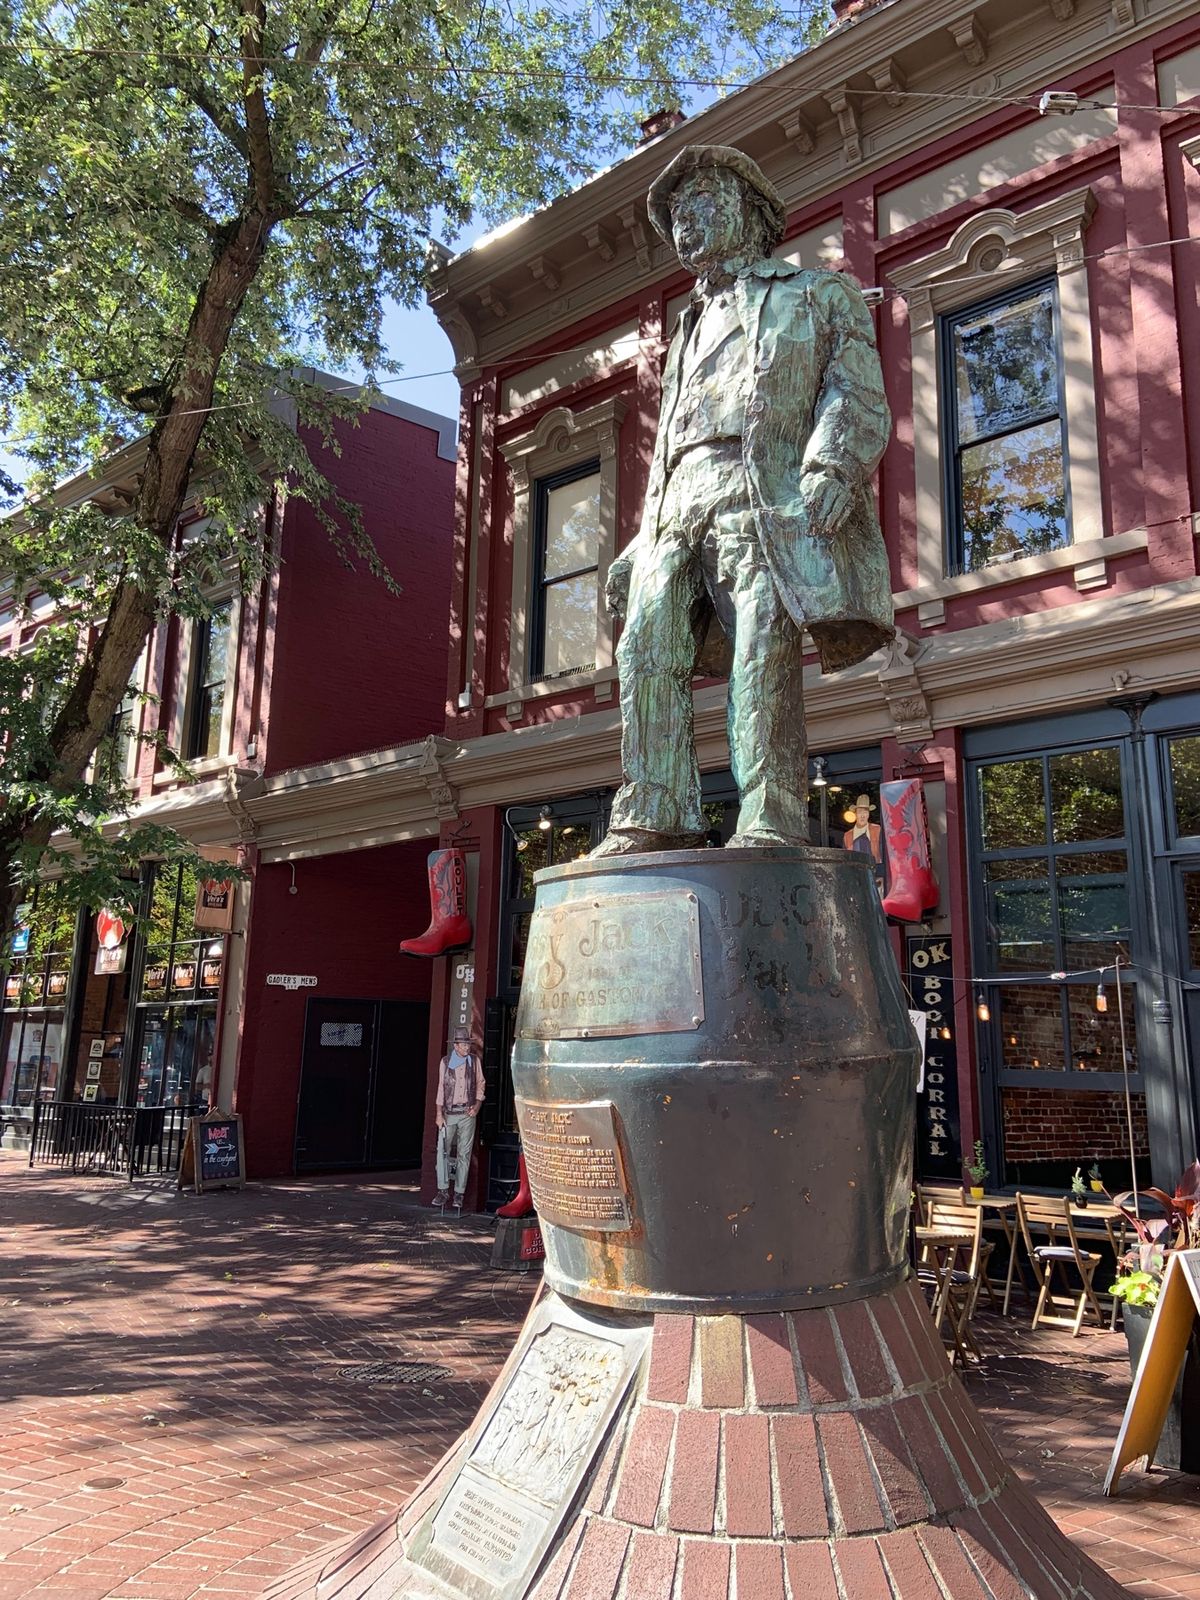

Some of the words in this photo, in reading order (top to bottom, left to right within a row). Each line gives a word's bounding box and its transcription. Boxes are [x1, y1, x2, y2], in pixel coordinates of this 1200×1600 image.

[454, 855, 463, 915] BOULET
[207, 895, 224, 903] Vera's
[912, 942, 951, 969] OK
[268, 975, 297, 984] GAOLER'S
[301, 977, 316, 985] MEWS
[456, 964, 475, 983] OK
[459, 988, 468, 1024] BOO
[552, 990, 570, 1010] OF
[923, 975, 942, 1040] BOOT
[926, 1056, 948, 1156] CORRAL
[216, 1152, 237, 1167] courtyard
